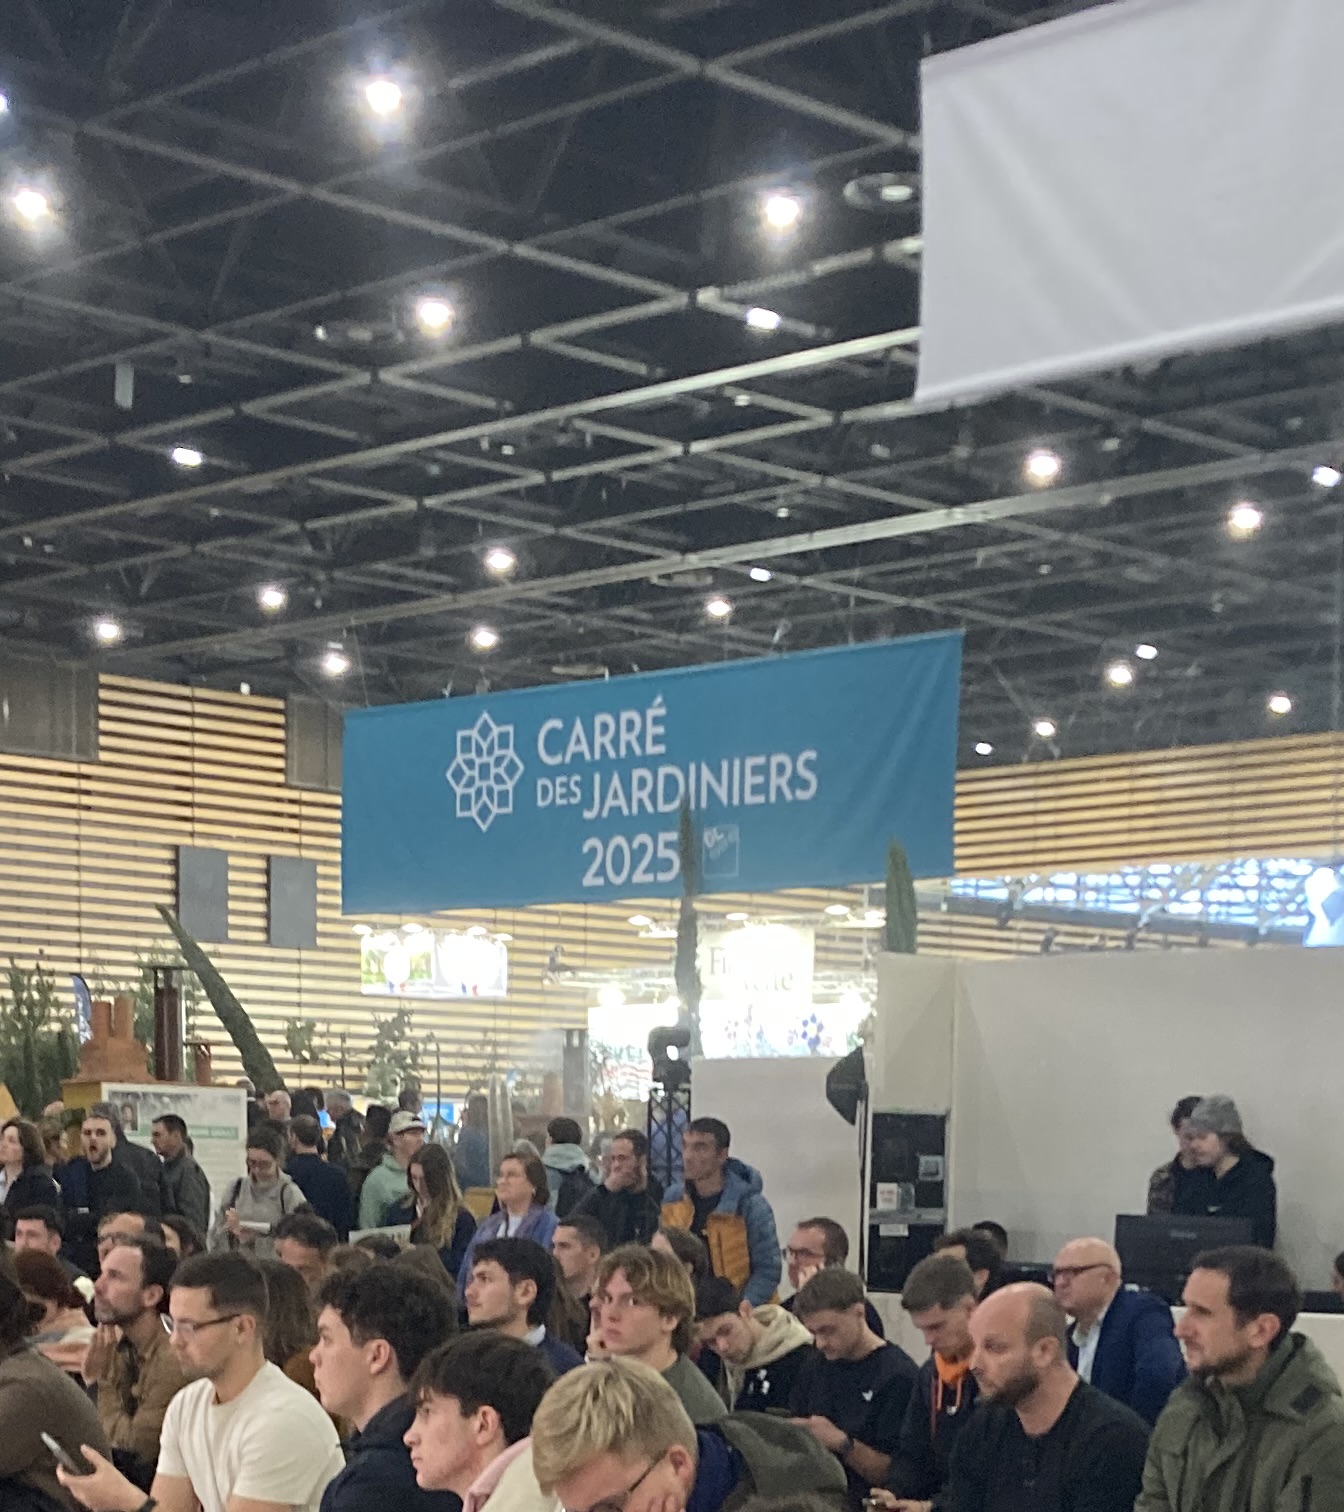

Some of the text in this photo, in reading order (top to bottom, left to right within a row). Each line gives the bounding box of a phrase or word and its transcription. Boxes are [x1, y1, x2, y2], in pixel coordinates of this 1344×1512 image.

[537, 694, 667, 766] CARRÉ
[536, 749, 818, 820] DES JARDINIERS
[582, 831, 681, 887] 2025
